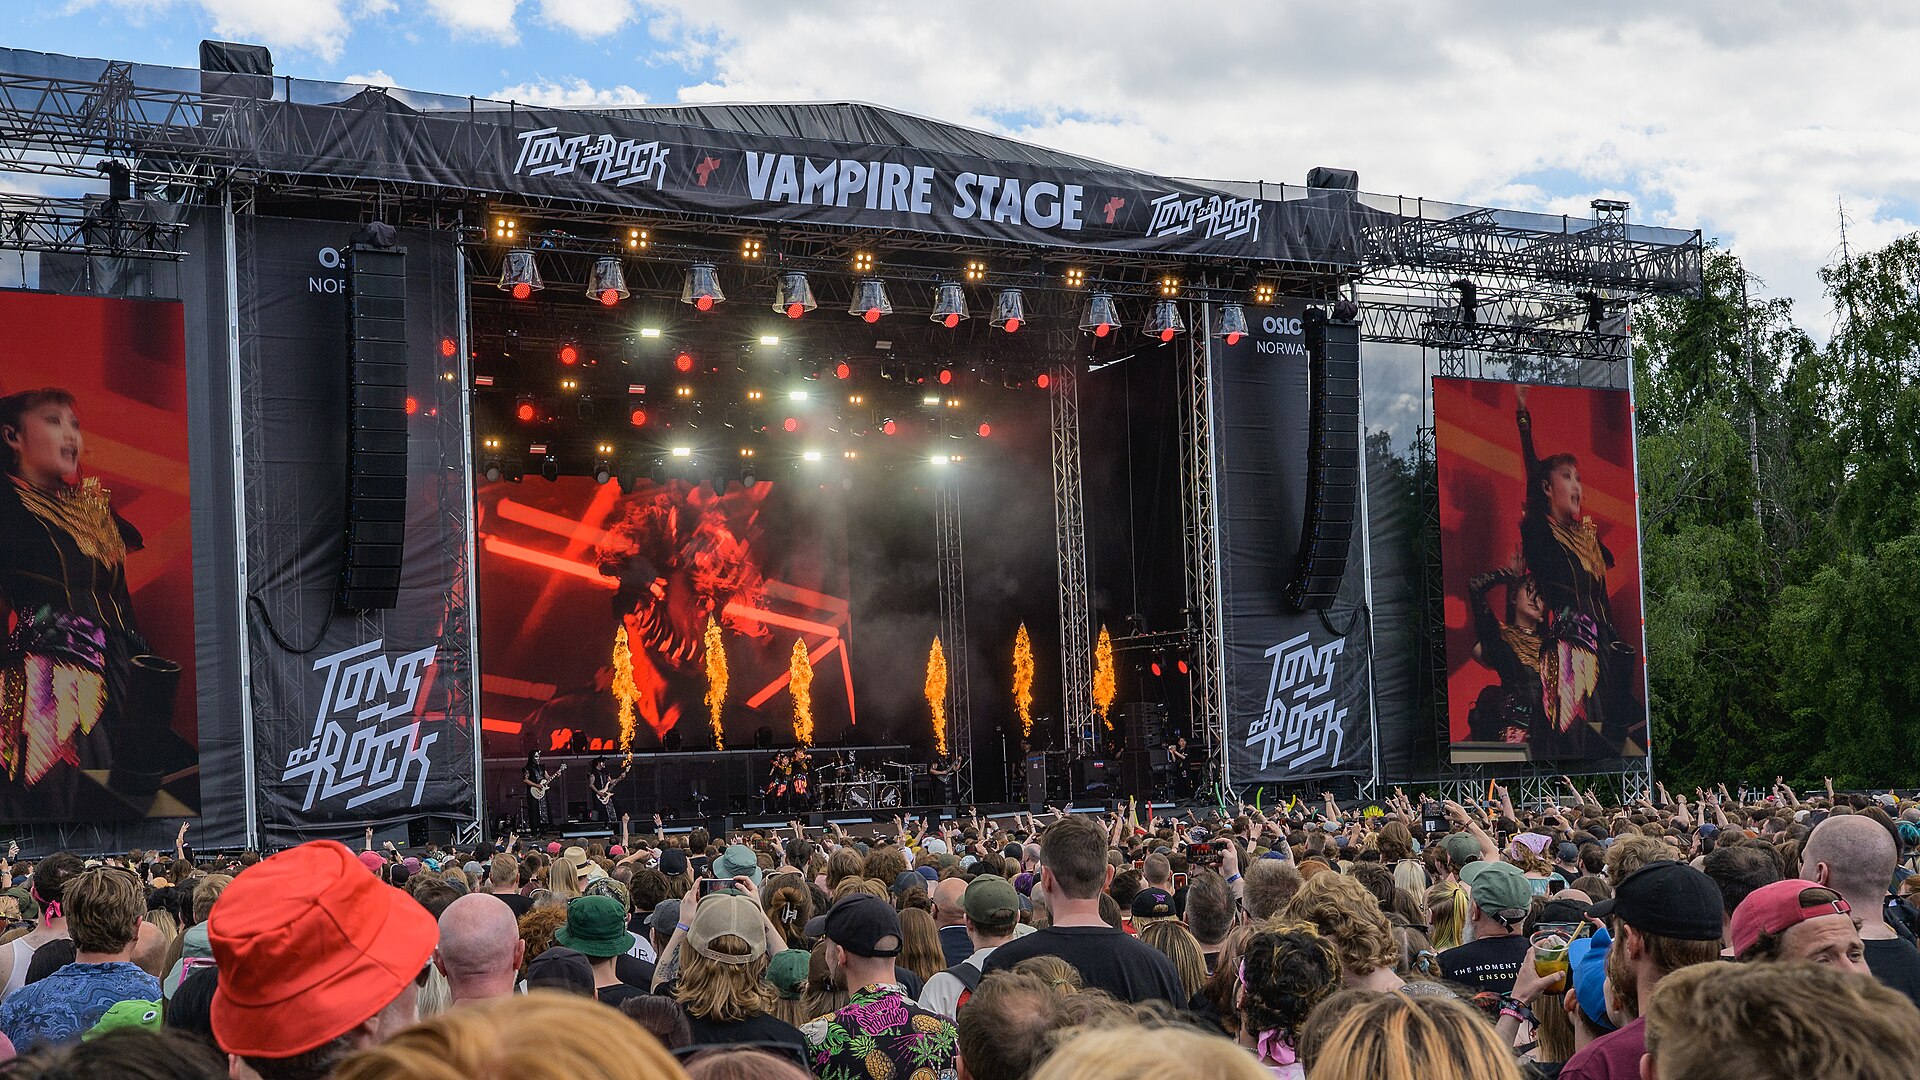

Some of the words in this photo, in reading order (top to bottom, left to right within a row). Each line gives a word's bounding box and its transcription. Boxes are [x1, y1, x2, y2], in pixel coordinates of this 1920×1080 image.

[580, 133, 671, 191] ROCK
[745, 150, 936, 215] VAMPIRE
[952, 172, 1084, 231] STAGE
[1196, 195, 1263, 242] ROCK
[281, 720, 439, 812] ROCK
[1245, 697, 1349, 771] ROCK
[1454, 966, 1473, 976] THE
[1475, 962, 1517, 972] MOMENT
